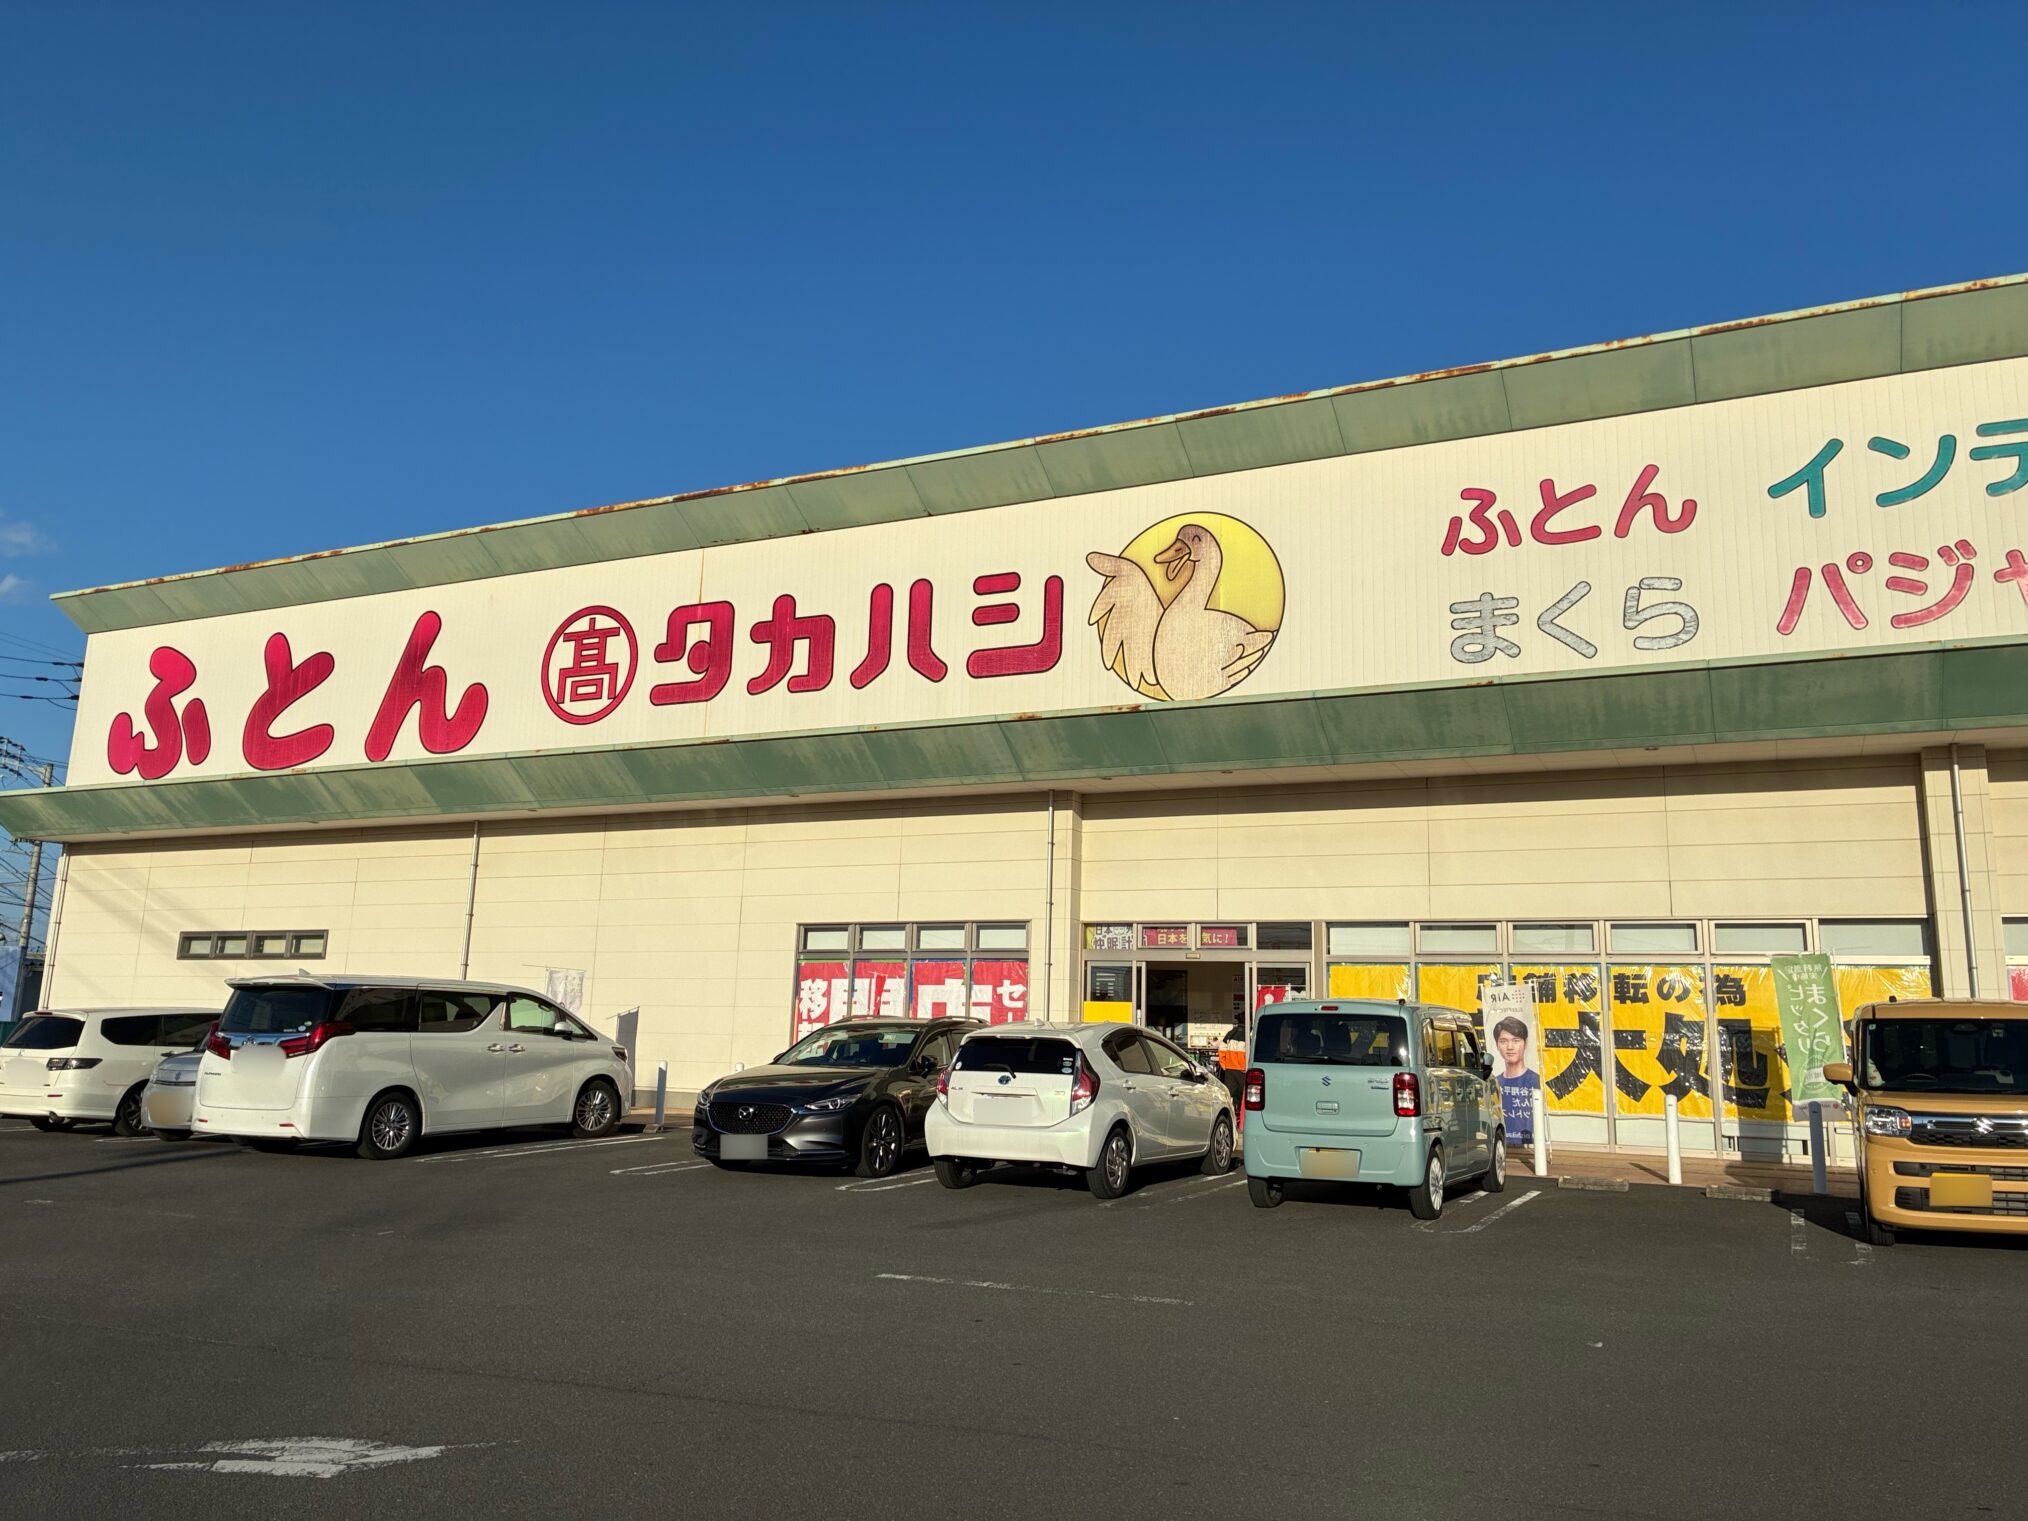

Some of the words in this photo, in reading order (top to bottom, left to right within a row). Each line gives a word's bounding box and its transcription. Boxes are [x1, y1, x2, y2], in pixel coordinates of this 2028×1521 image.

[1440, 463, 1698, 556] ふとん
[1449, 576, 1700, 664] まくら
[107, 610, 488, 779] ふとん
[650, 571, 1064, 707] タカハシ
[1094, 936, 1134, 950] 快眠計
